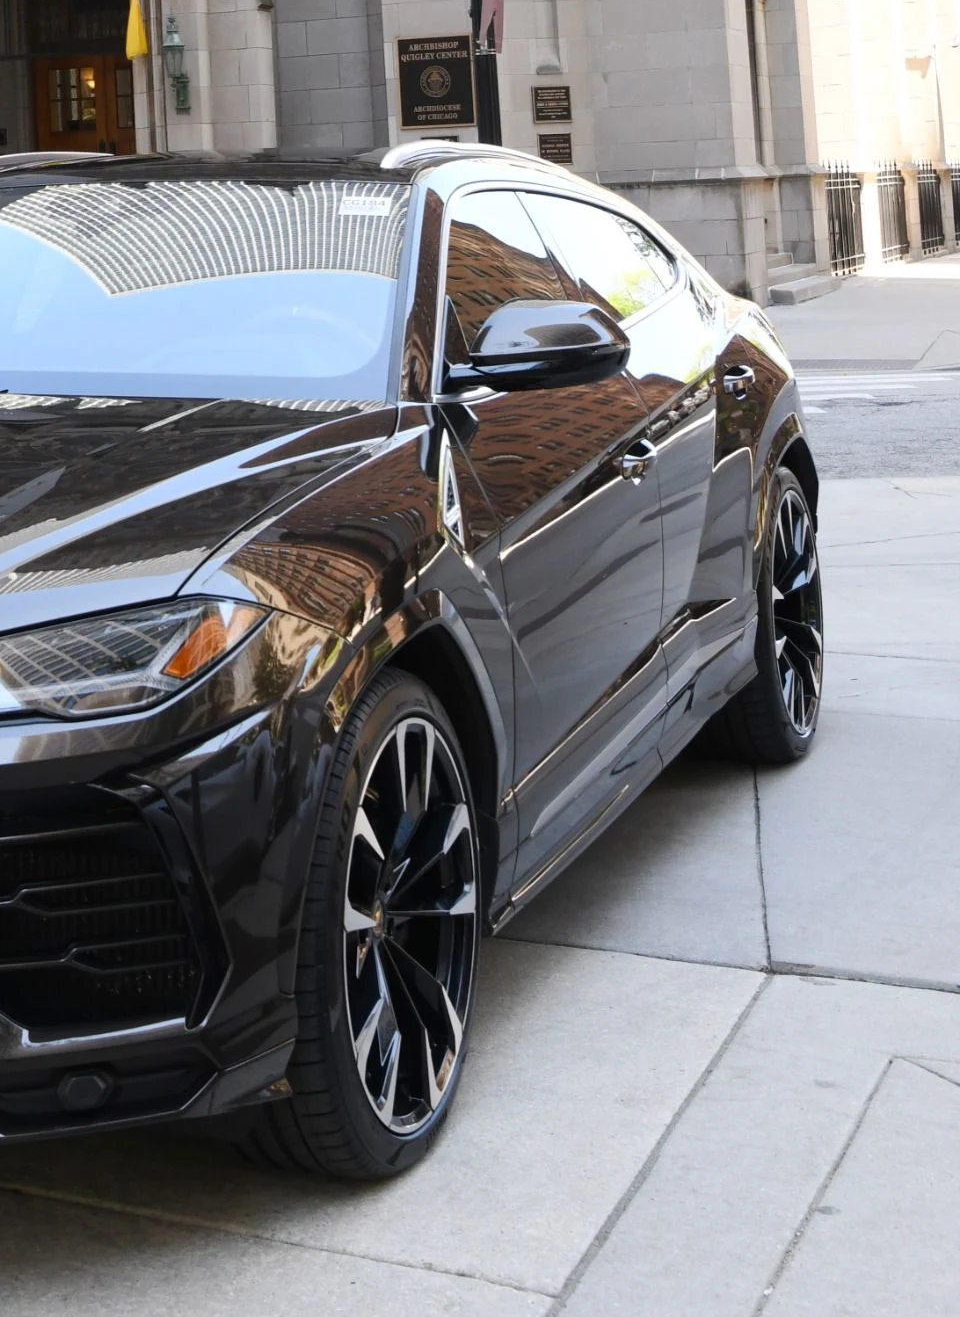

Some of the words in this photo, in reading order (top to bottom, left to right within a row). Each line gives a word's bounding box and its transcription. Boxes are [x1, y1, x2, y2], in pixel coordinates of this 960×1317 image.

[408, 42, 458, 51] ARCHBISHOP
[401, 53, 435, 62] QUIGLEY
[436, 51, 467, 59] CENTER
